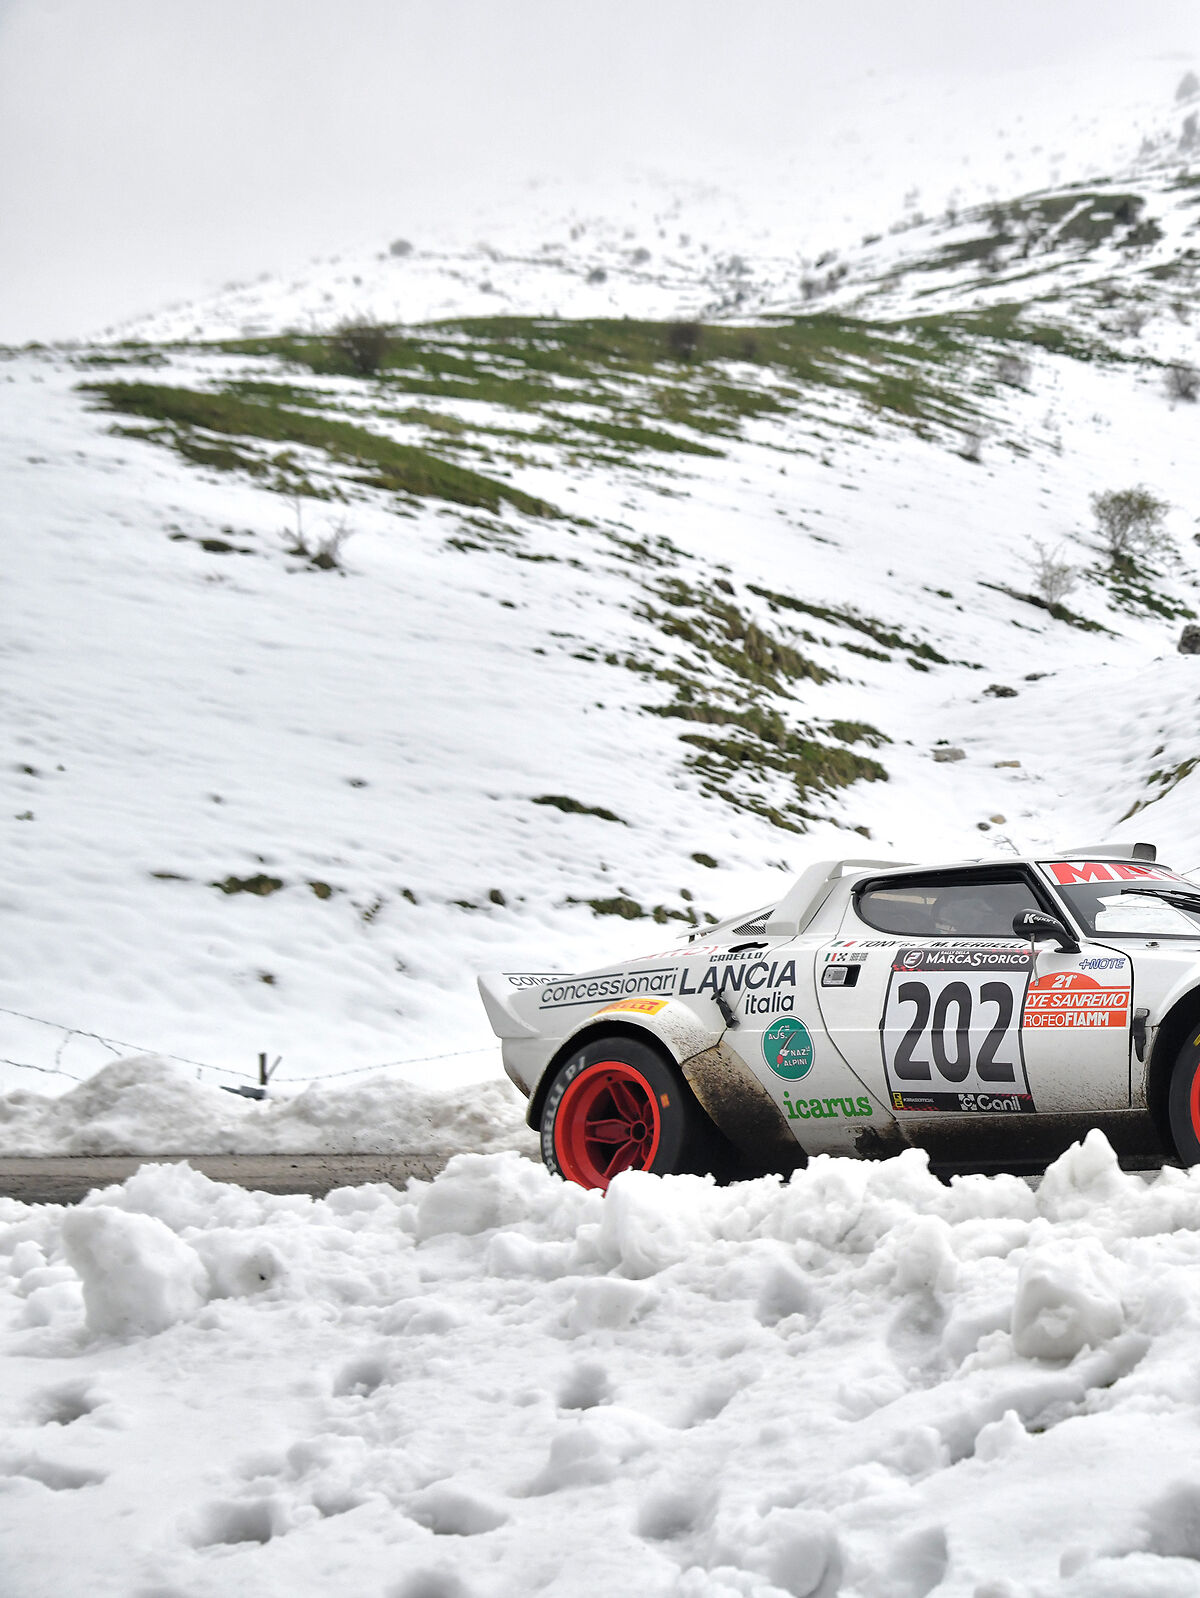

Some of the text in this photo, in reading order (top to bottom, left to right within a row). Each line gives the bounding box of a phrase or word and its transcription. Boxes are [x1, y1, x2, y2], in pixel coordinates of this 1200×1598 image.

[541, 960, 797, 1003] concessionari LANCIA
[744, 992, 795, 1015] italia
[1025, 993, 1127, 1007] LYE SANREMO
[893, 981, 1017, 1083] 202
[784, 1059, 808, 1067] ALPINI
[782, 1090, 873, 1120] icarus
[977, 1094, 1022, 1111] Canil
